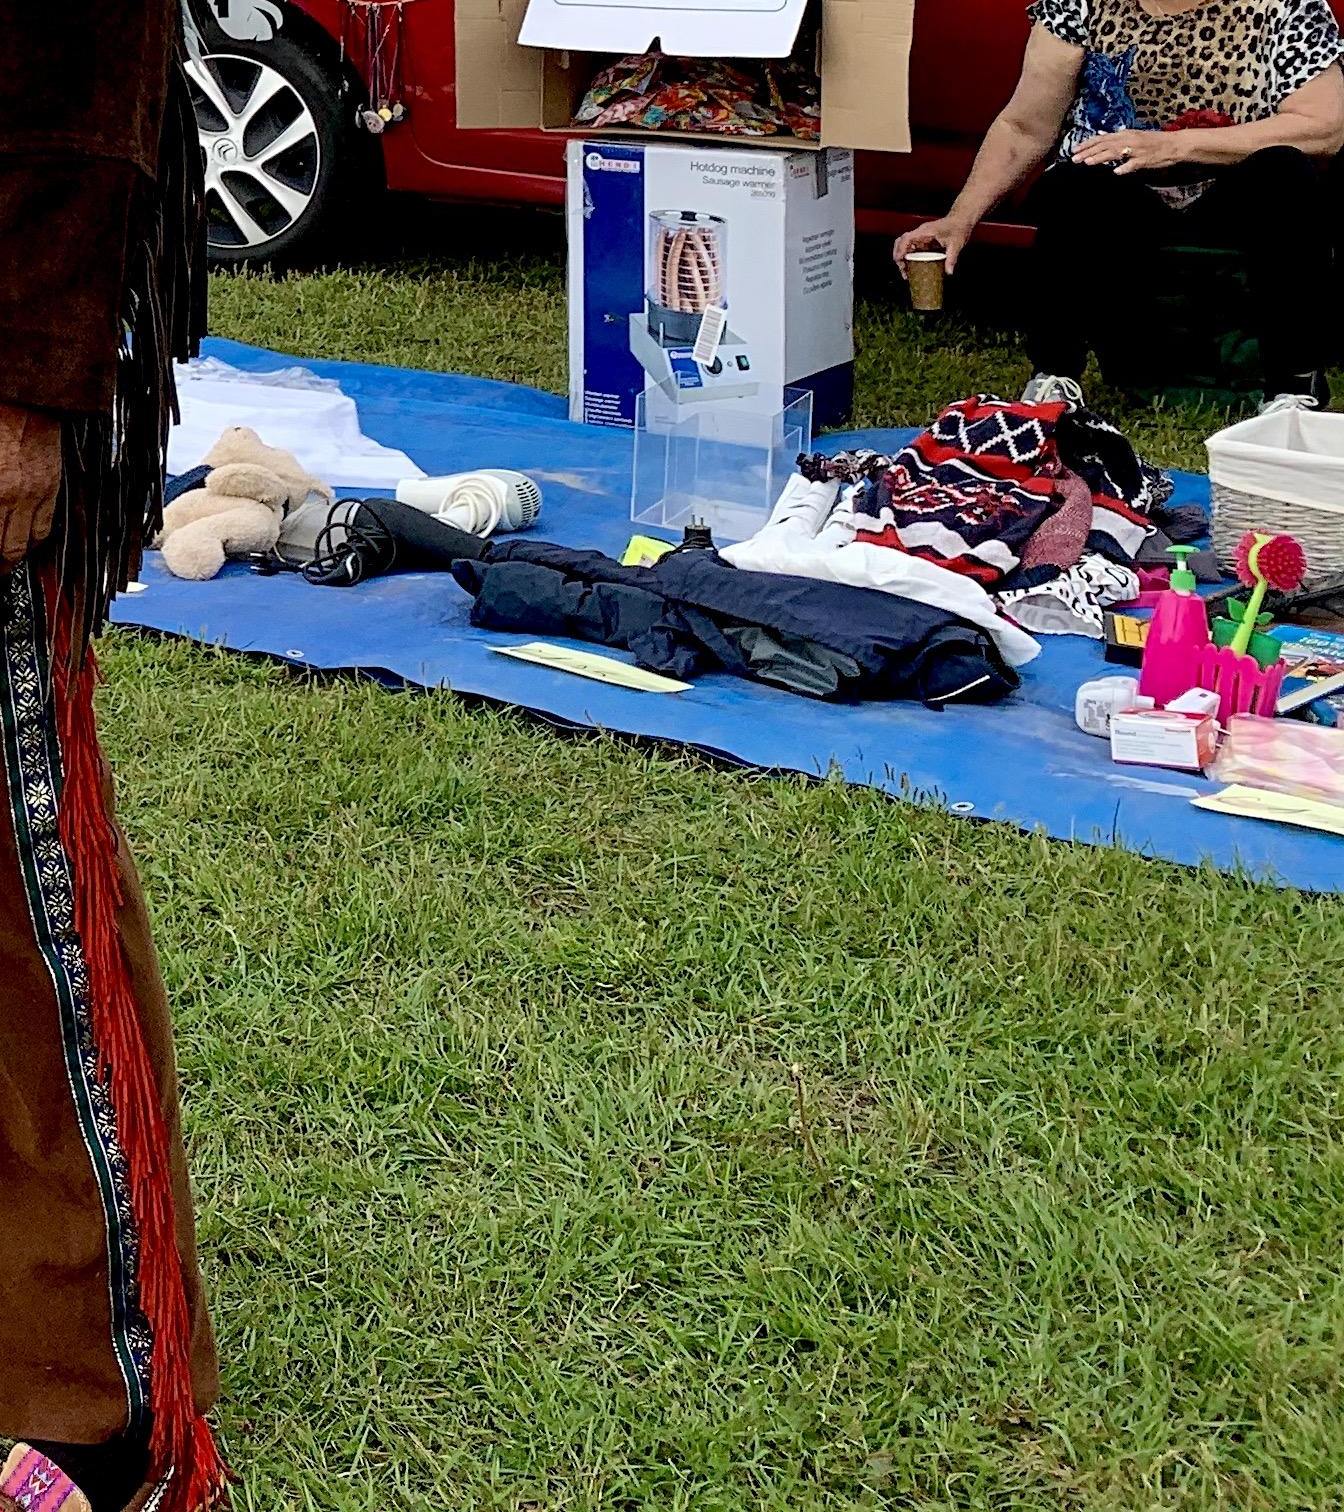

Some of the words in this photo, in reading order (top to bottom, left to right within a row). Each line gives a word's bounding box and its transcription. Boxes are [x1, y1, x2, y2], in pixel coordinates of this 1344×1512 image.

[690, 161, 727, 175] Hotdog
[730, 165, 775, 176] machine
[702, 175, 740, 188] Sausage
